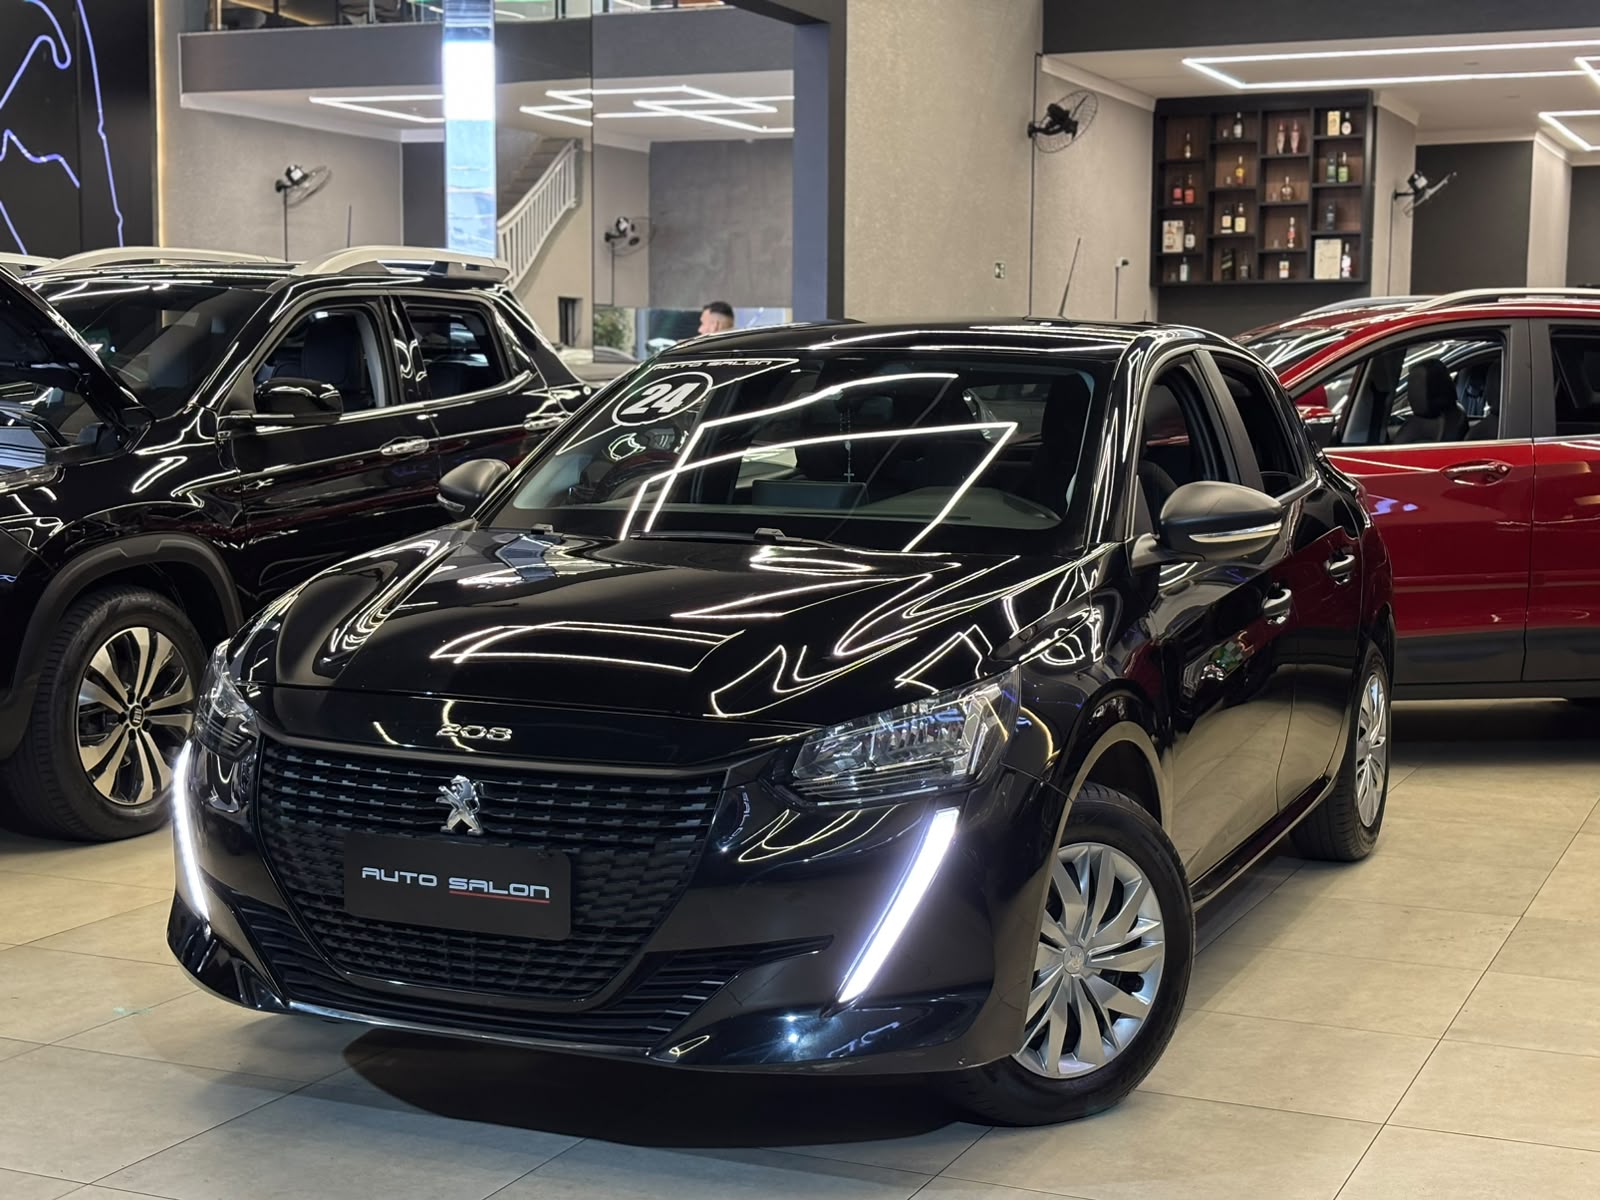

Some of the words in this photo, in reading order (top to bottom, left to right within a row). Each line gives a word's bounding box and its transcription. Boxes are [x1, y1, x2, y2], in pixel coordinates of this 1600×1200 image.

[653, 361, 703, 371] AUTO
[706, 359, 773, 367] SALON
[620, 382, 701, 416] 24
[436, 722, 513, 741] 208
[361, 866, 438, 888] AUTO
[448, 877, 550, 899] SALON
